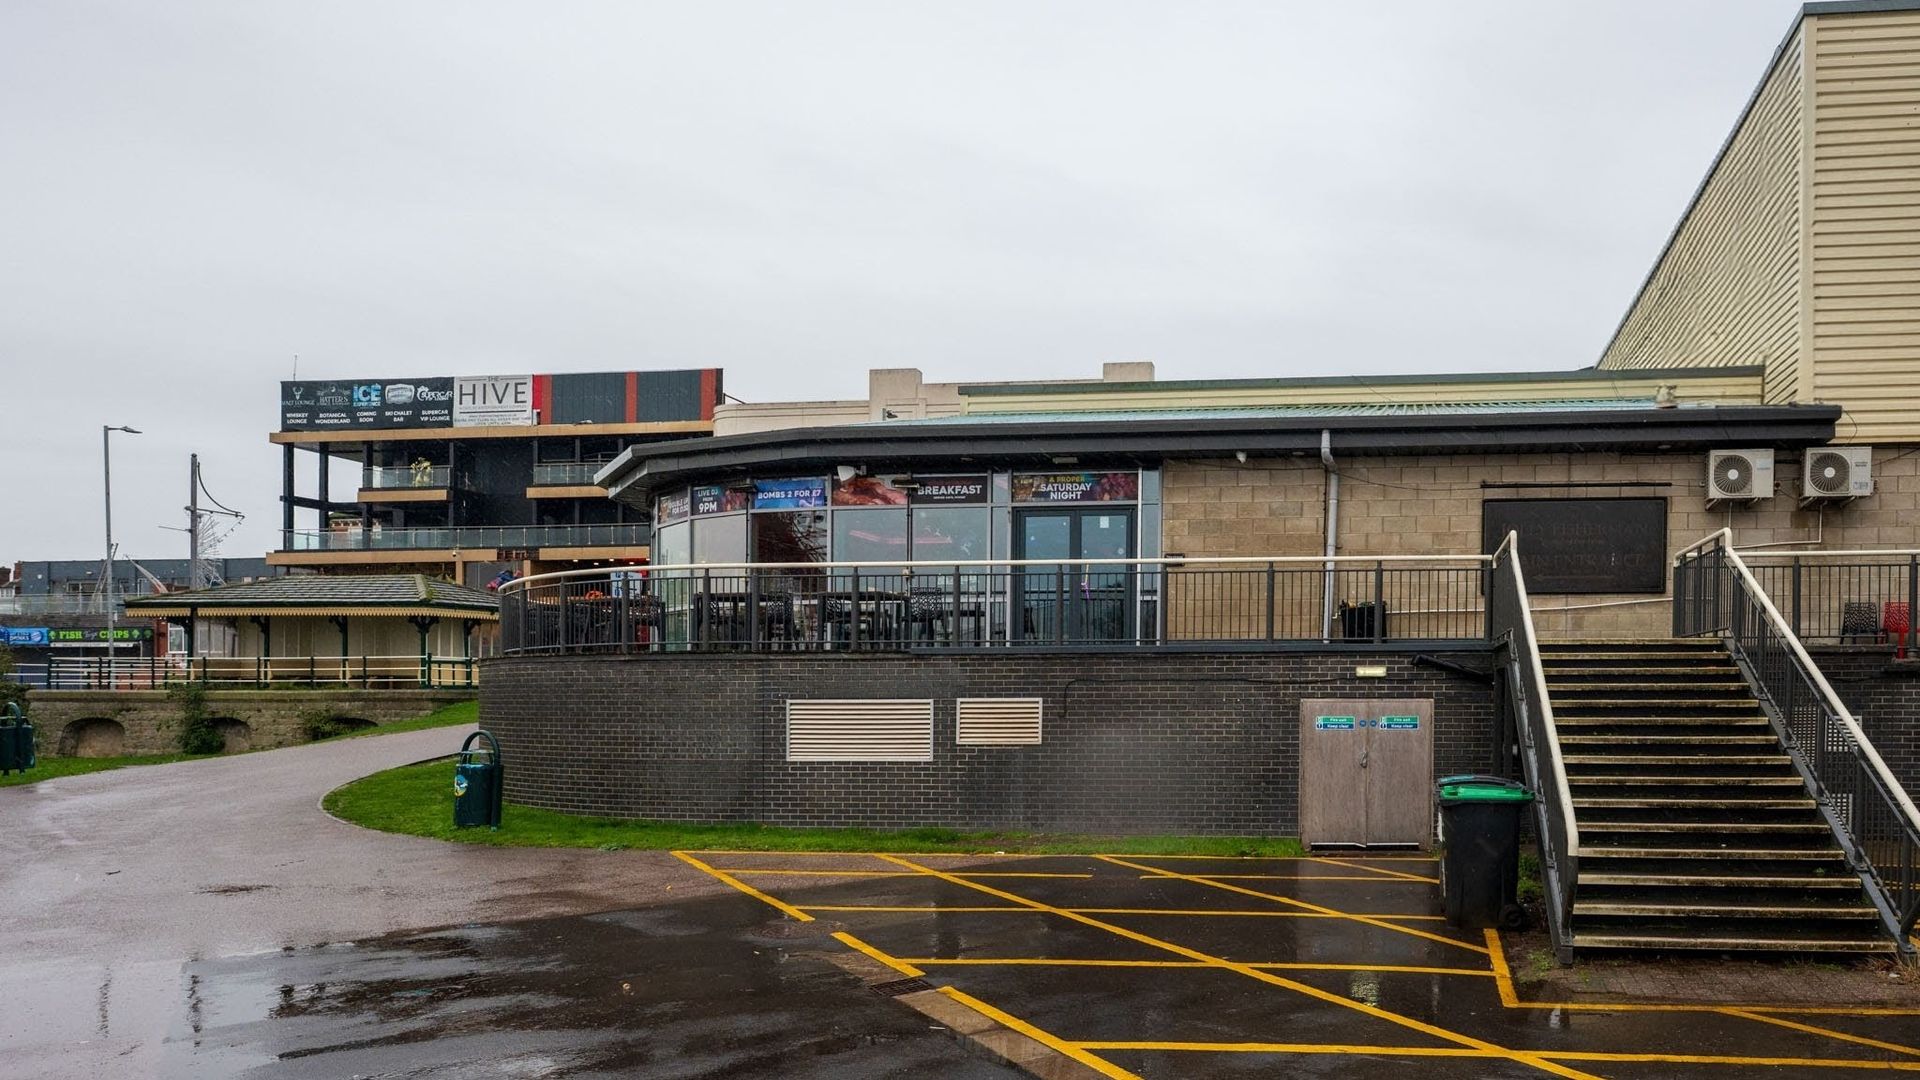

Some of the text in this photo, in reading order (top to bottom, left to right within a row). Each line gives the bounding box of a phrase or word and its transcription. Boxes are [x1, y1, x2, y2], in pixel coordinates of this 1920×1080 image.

[459, 382, 528, 405] HIVE
[917, 485, 983, 495] BREAKFAST
[1040, 483, 1092, 492] SATURDAY
[758, 491, 786, 499] BOMBS
[794, 490, 810, 498] FOR
[812, 489, 822, 497] £7
[1050, 491, 1082, 500] NIGHT
[699, 501, 717, 513] 9PM
[59, 630, 82, 639] FISH
